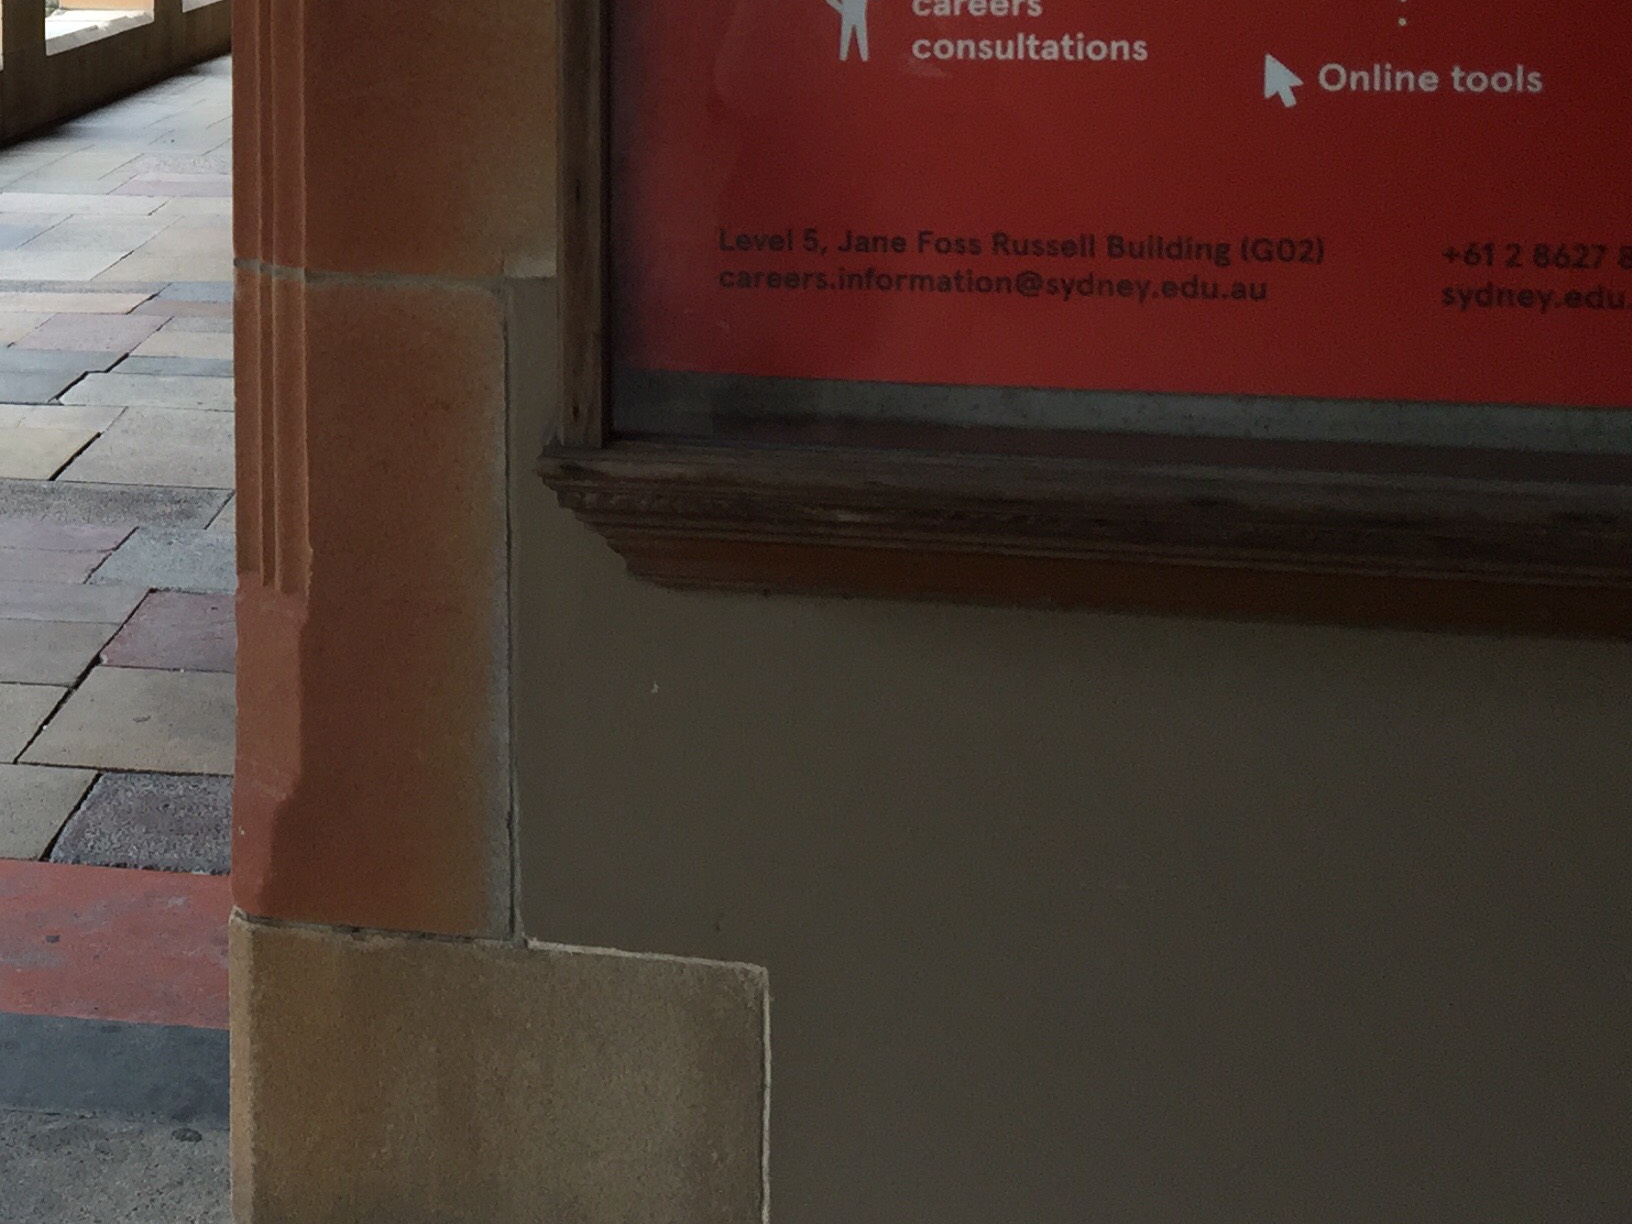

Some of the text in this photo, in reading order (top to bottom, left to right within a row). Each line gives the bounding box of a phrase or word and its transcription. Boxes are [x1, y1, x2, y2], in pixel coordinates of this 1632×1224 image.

[913, 32, 1148, 61] consultations
[1319, 63, 1543, 93] Online tools
[719, 228, 793, 253] Level
[803, 228, 827, 256] 5,
[837, 230, 907, 255] Jane
[917, 230, 982, 257] Foss
[991, 231, 1096, 259] Russell
[1106, 233, 1231, 267] Building
[1443, 241, 1495, 267] +61
[1505, 242, 1523, 268] 2
[1532, 243, 1608, 270] 8627
[719, 266, 1267, 303] careers.information@sydney.edu.au
